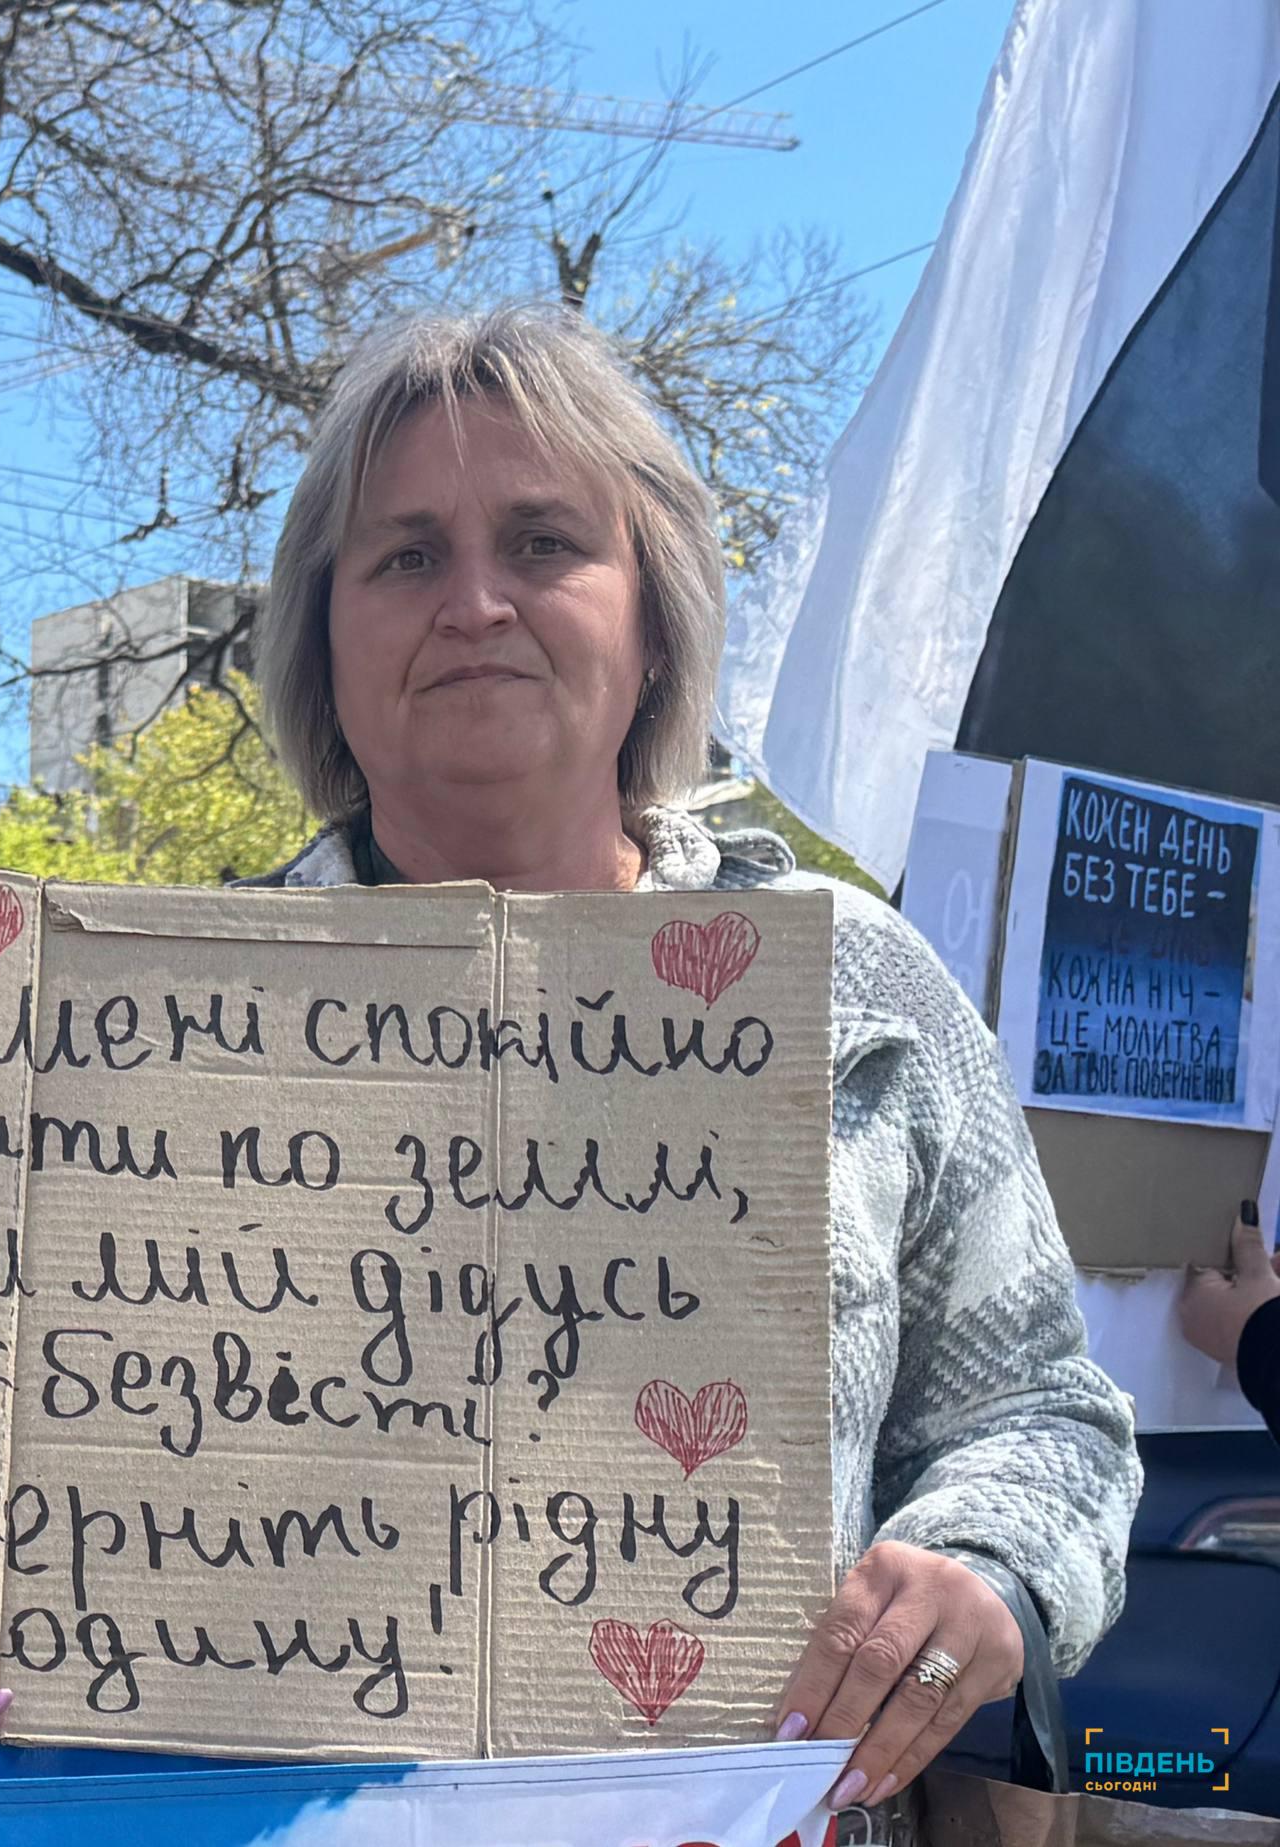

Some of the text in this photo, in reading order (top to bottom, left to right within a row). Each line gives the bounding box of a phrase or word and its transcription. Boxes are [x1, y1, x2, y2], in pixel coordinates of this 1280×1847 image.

[1065, 788, 1232, 874] КОЖЕН ДЕНЬ
[1063, 852, 1115, 903] БЕЗ
[1124, 863, 1196, 918] ТЕБЕ
[1047, 951, 1135, 1008] КОЖНА
[1148, 972, 1195, 1015] НІЧ
[305, 988, 774, 1084] спокійно
[1034, 1049, 1067, 1094] ЗА
[1050, 1011, 1223, 1063] ЦЕ МОЛИТВА
[220, 1127, 340, 1191] по
[385, 1130, 749, 1235] землі,
[72, 1222, 319, 1314] мій
[350, 1250, 700, 1412] дідусь
[450, 1478, 740, 1620] рідну
